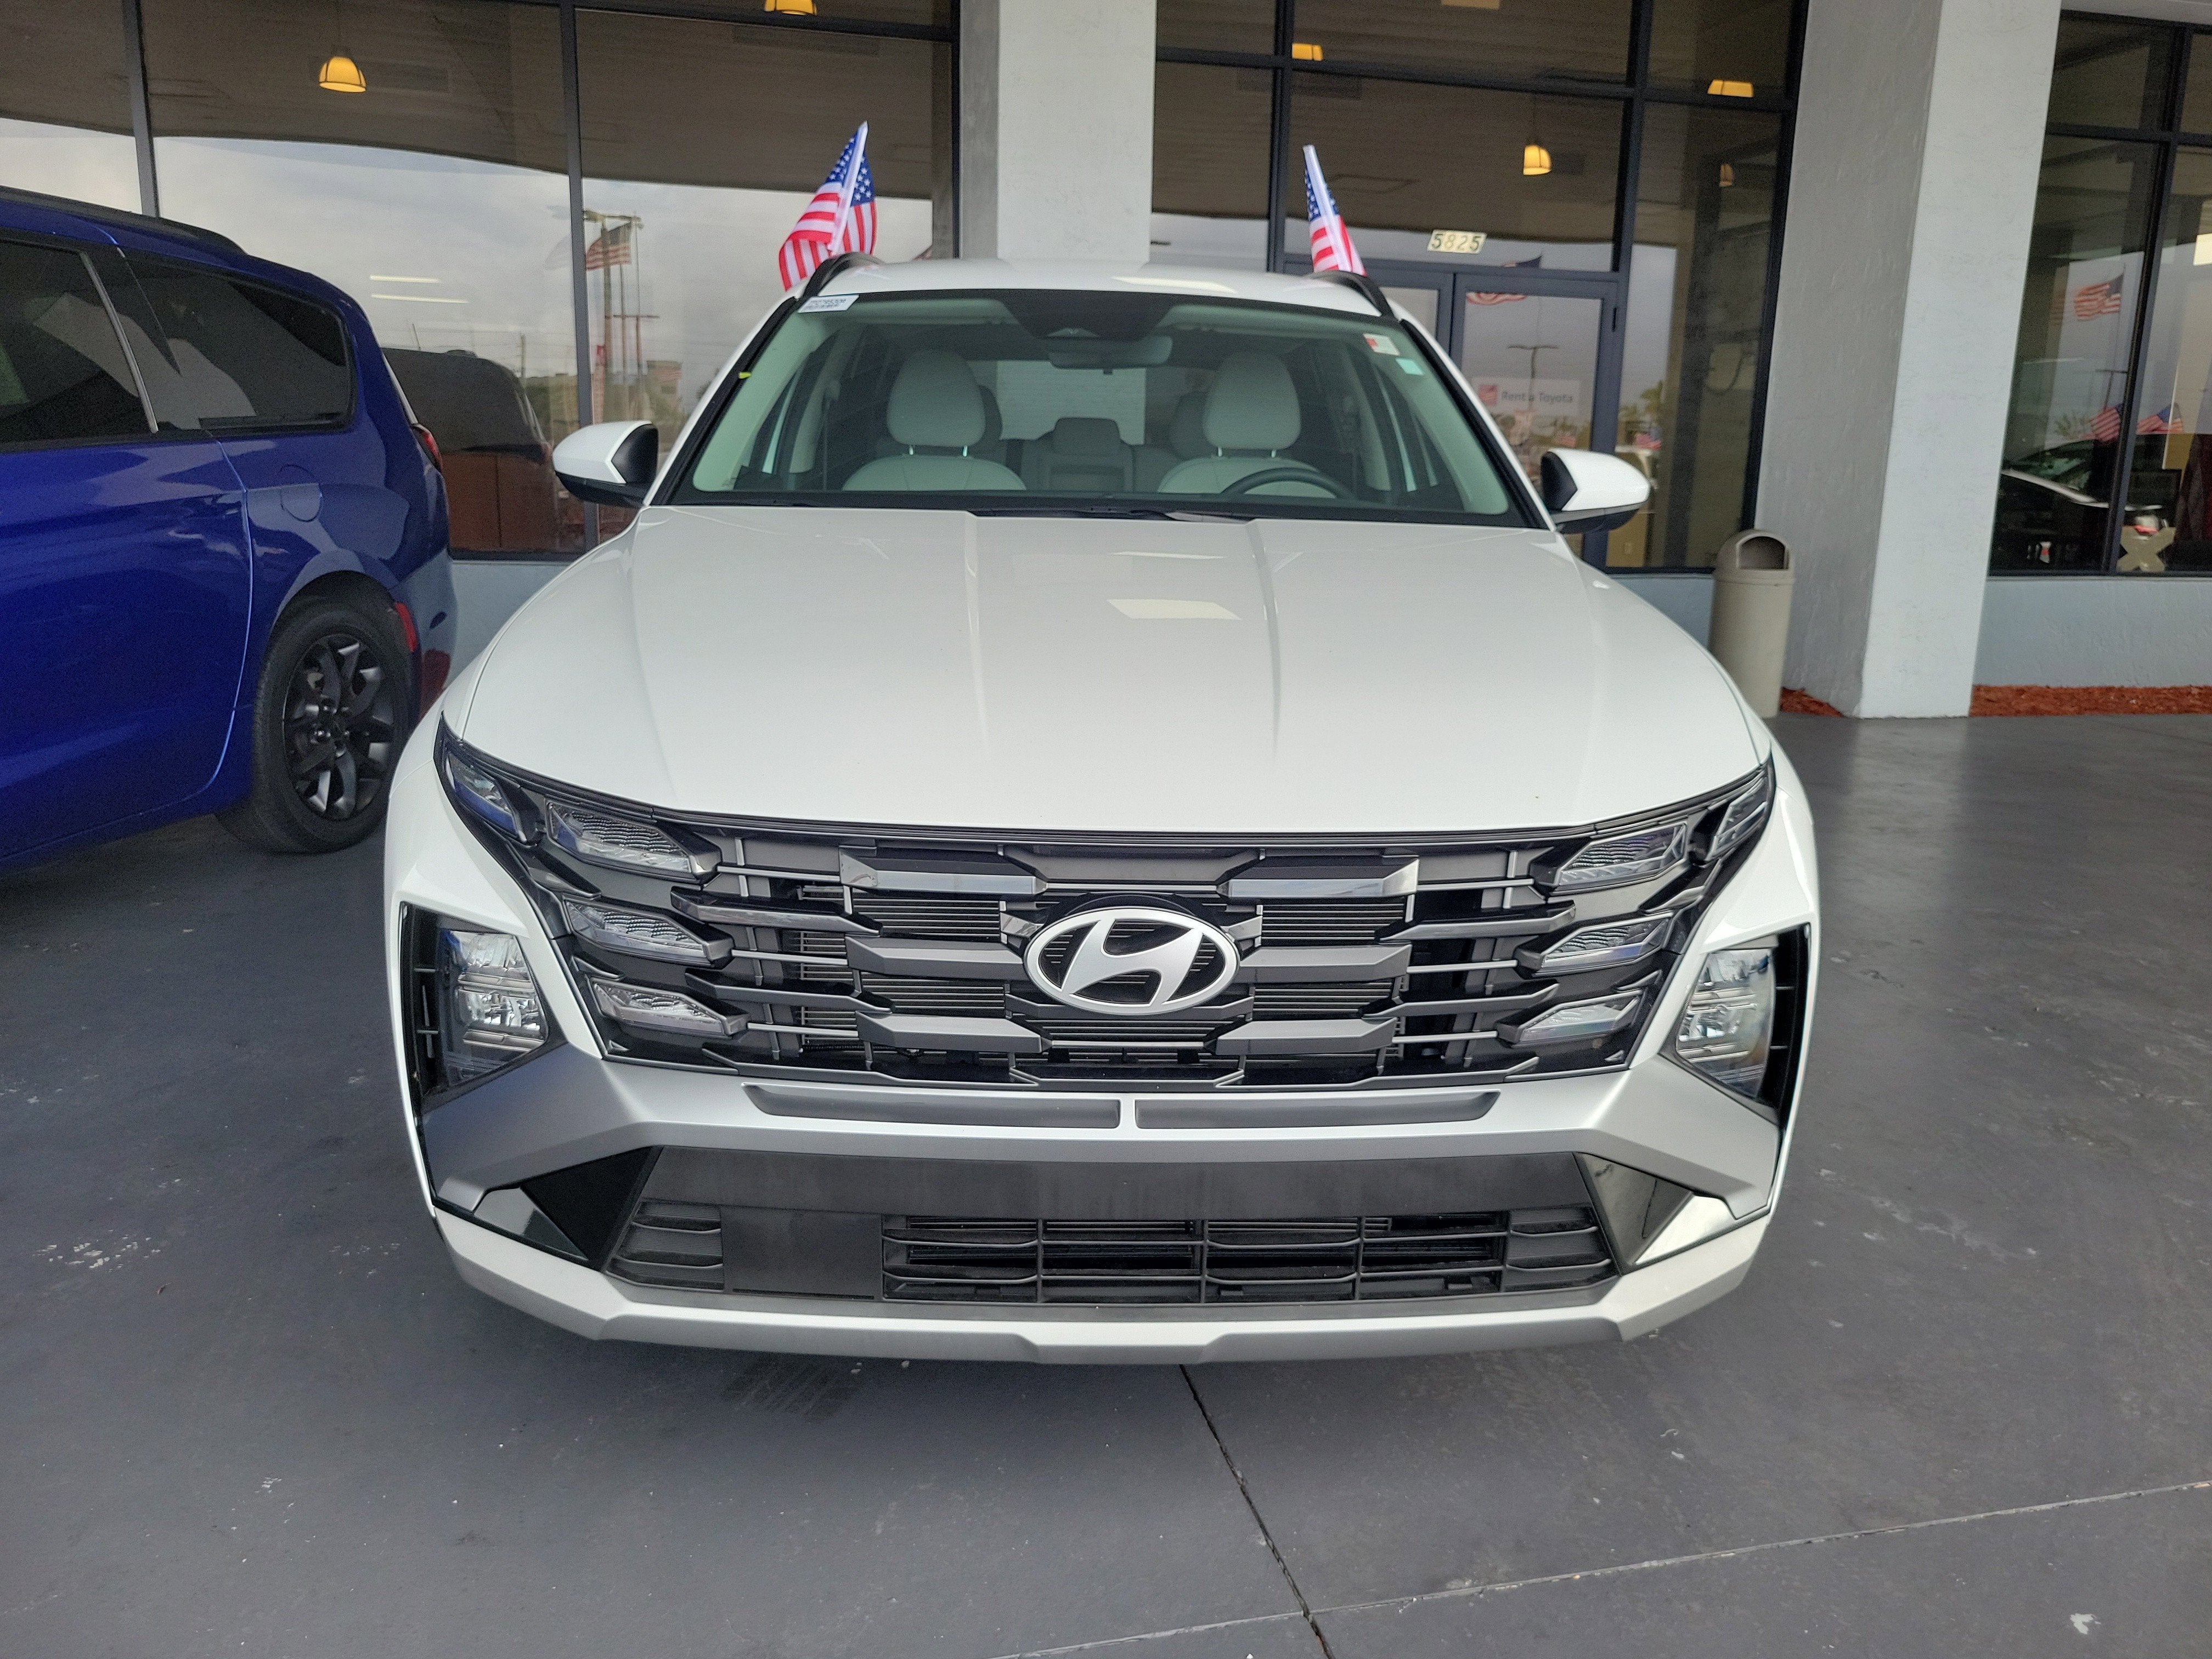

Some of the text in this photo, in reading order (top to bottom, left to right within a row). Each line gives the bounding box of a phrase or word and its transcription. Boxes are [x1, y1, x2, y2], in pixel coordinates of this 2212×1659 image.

[1432, 234, 1481, 251] 5825
[1502, 392, 1525, 401] Rent
[1539, 392, 1573, 405] Toyota
